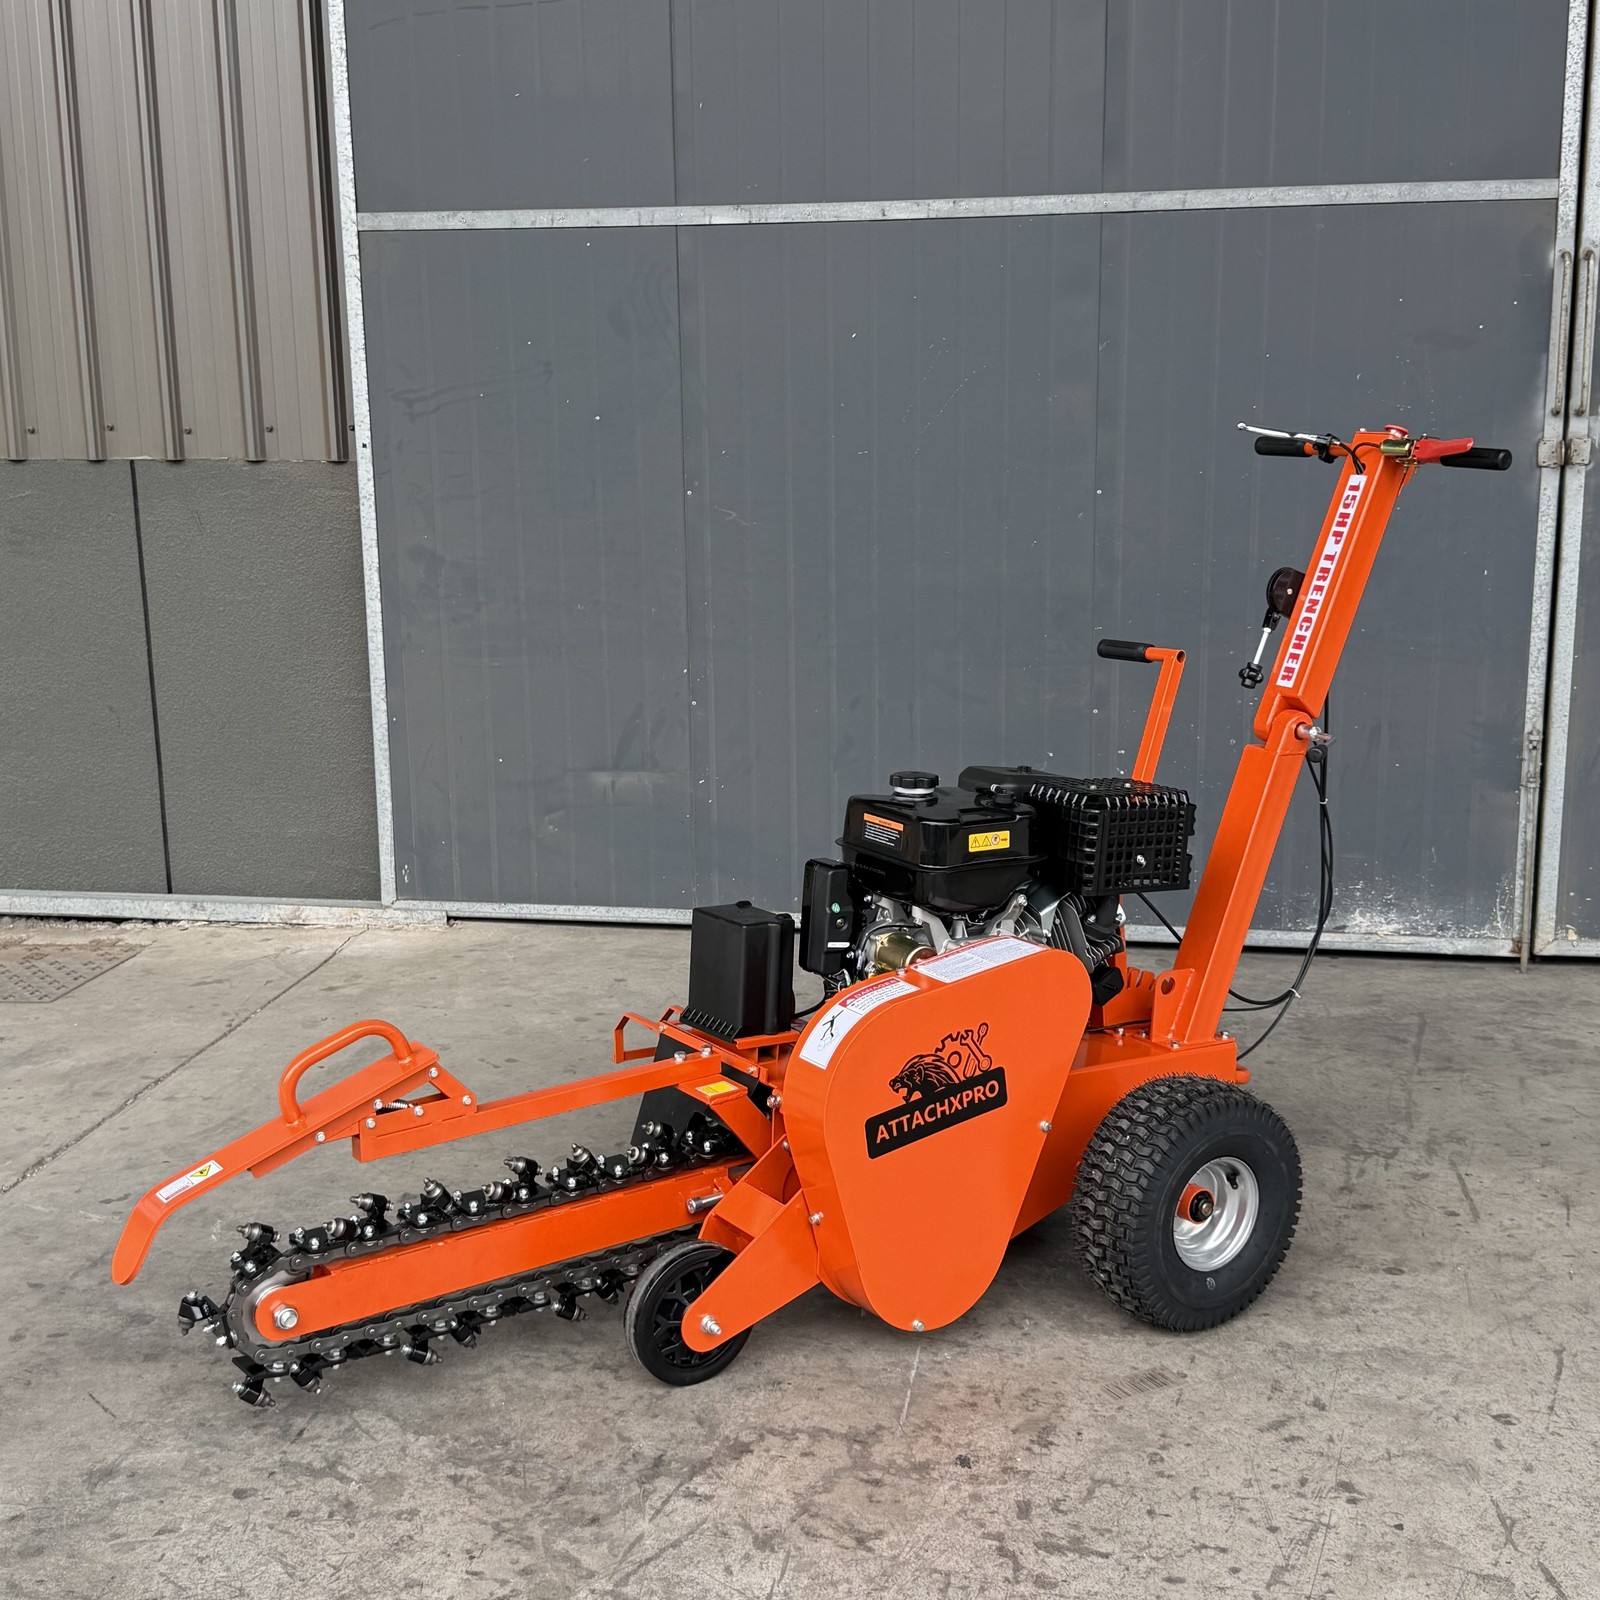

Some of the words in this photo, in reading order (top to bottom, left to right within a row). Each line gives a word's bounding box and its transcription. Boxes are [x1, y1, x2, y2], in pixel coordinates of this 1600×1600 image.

[1331, 480, 1362, 545] 15HP
[1280, 551, 1338, 683] TRENCHER
[876, 1080, 999, 1144] ATTACHXPRO
